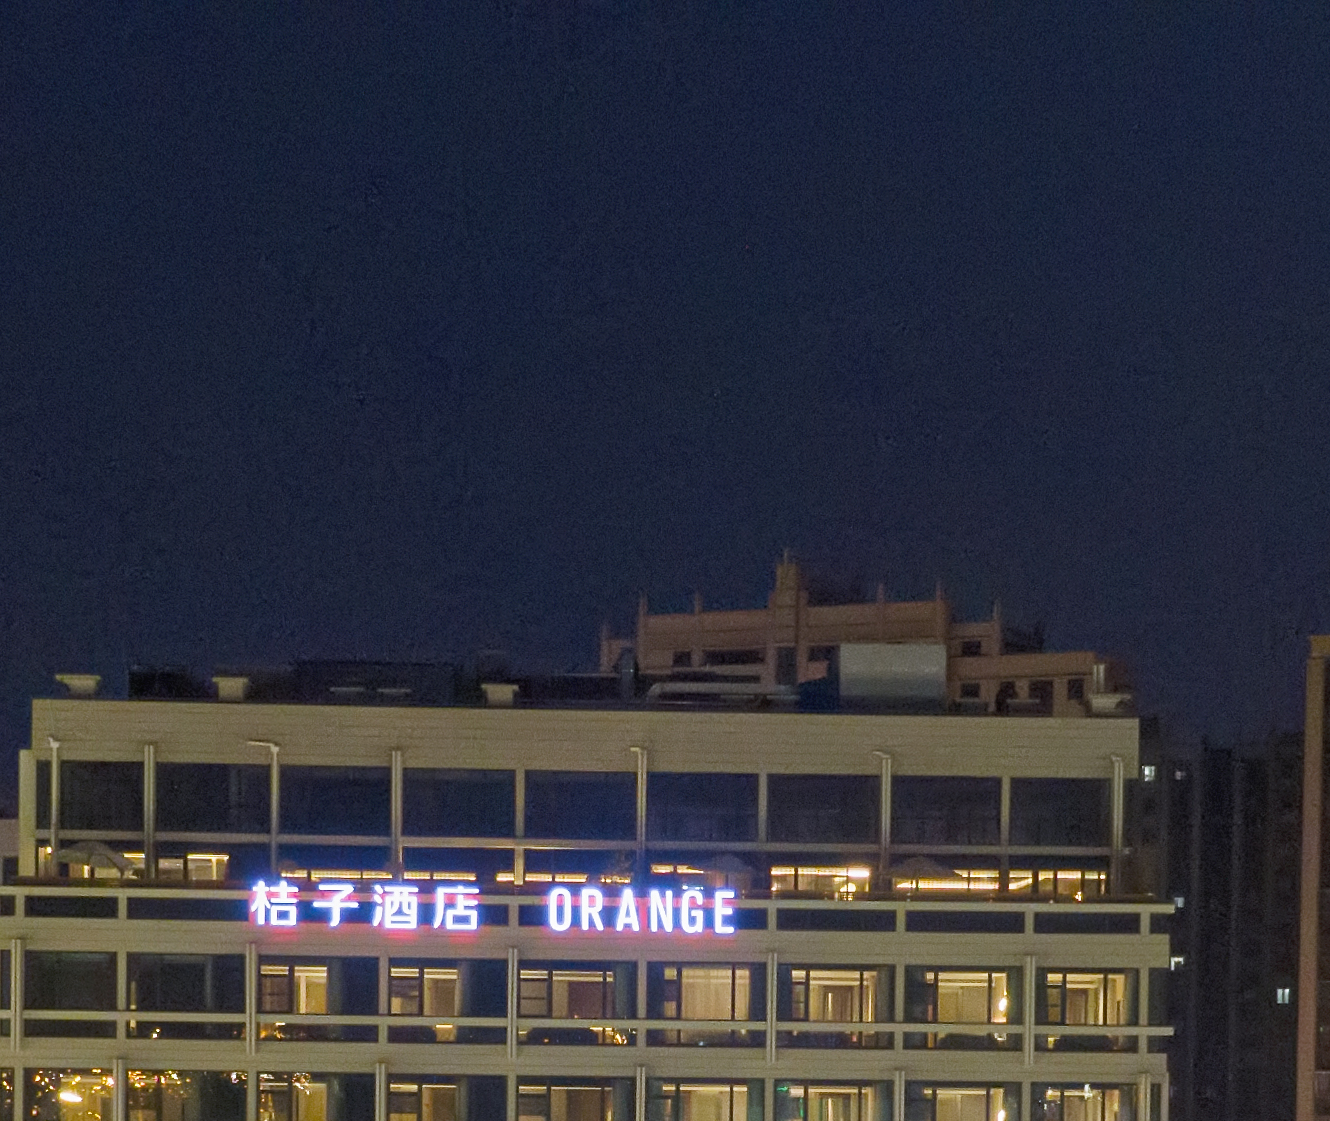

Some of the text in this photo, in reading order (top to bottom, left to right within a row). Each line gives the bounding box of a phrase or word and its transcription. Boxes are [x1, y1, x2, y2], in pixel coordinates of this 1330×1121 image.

[251, 880, 736, 935] 桔子酒店 ORANGE
